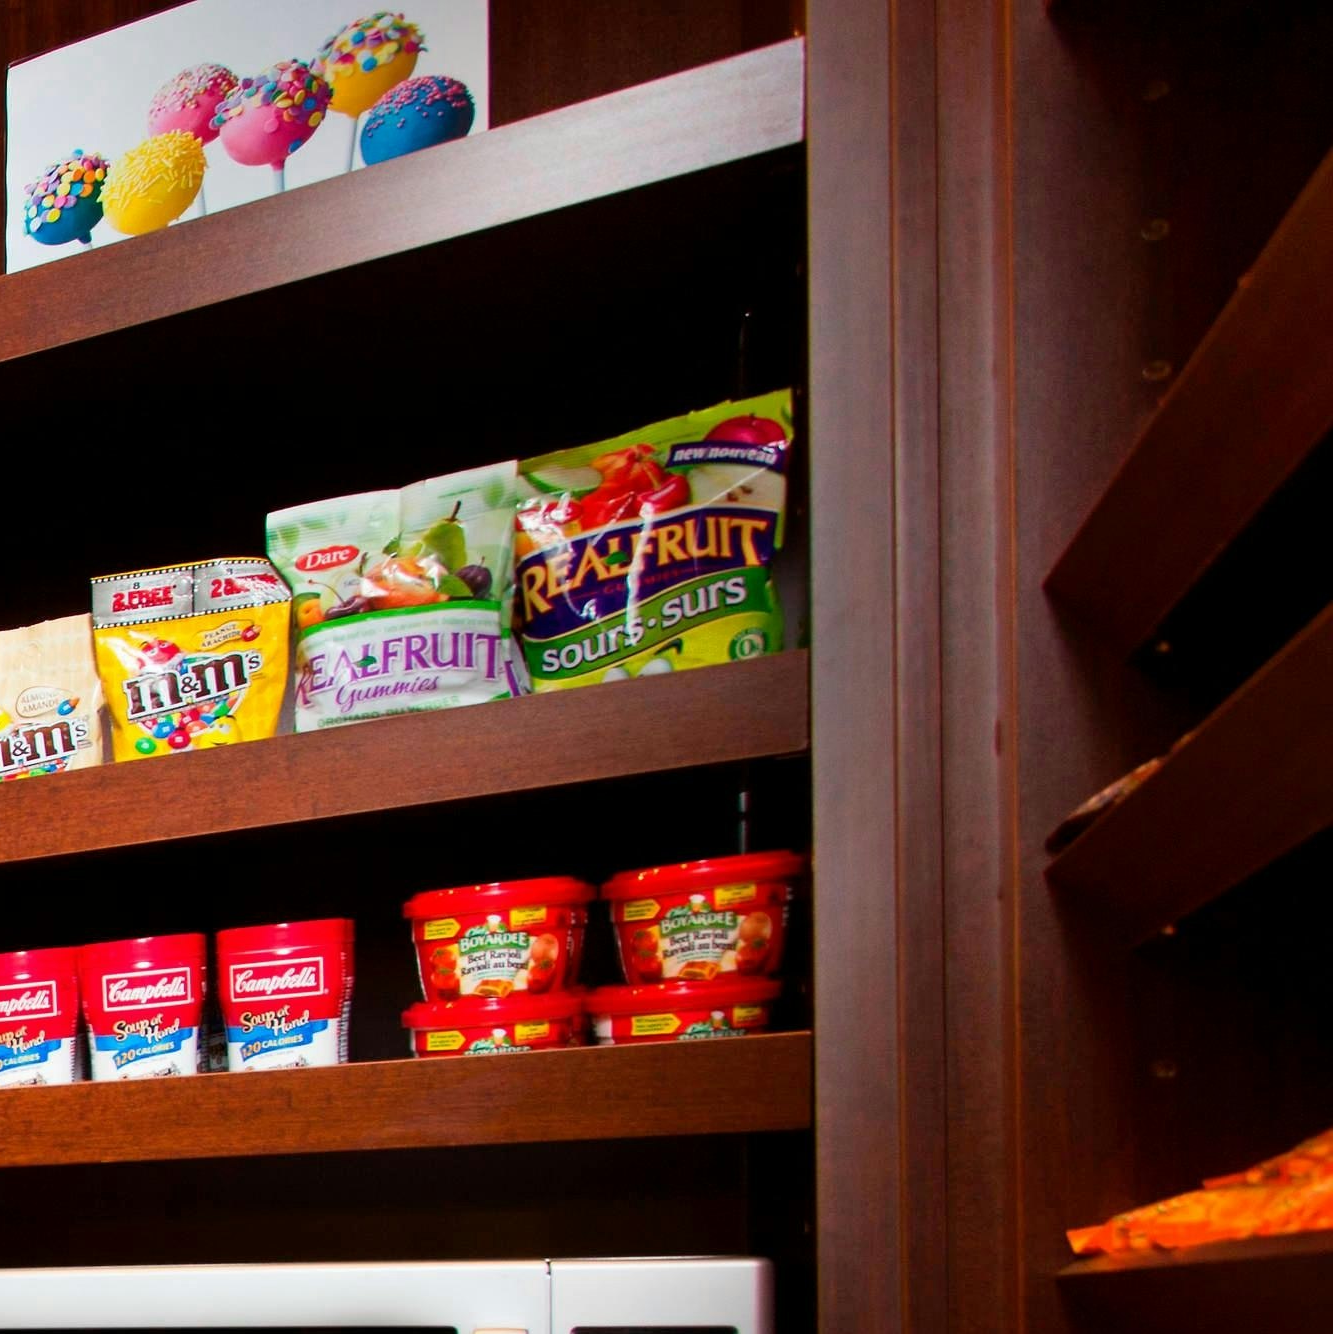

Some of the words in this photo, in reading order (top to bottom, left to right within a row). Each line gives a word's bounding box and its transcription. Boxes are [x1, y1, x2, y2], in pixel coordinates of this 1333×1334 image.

[305, 547, 351, 570] Dare
[541, 616, 644, 673] sours
[661, 576, 747, 629] surs
[335, 674, 439, 713] Gummies
[660, 911, 737, 934] BOYARDEE
[459, 931, 529, 953] BOYARDEE
[669, 933, 691, 946] Beef
[467, 952, 489, 965] Beef
[108, 975, 186, 1003] Campbell's
[235, 966, 317, 994] Campbell's
[113, 1020, 151, 1042] Soup
[150, 1013, 163, 1030] at
[146, 1017, 180, 1044] Hand
[239, 1011, 275, 1034] Soup
[274, 1004, 290, 1019] at
[272, 1010, 309, 1036] Hand
[12, 1030, 45, 1055] Hand
[13, 1026, 27, 1039] at
